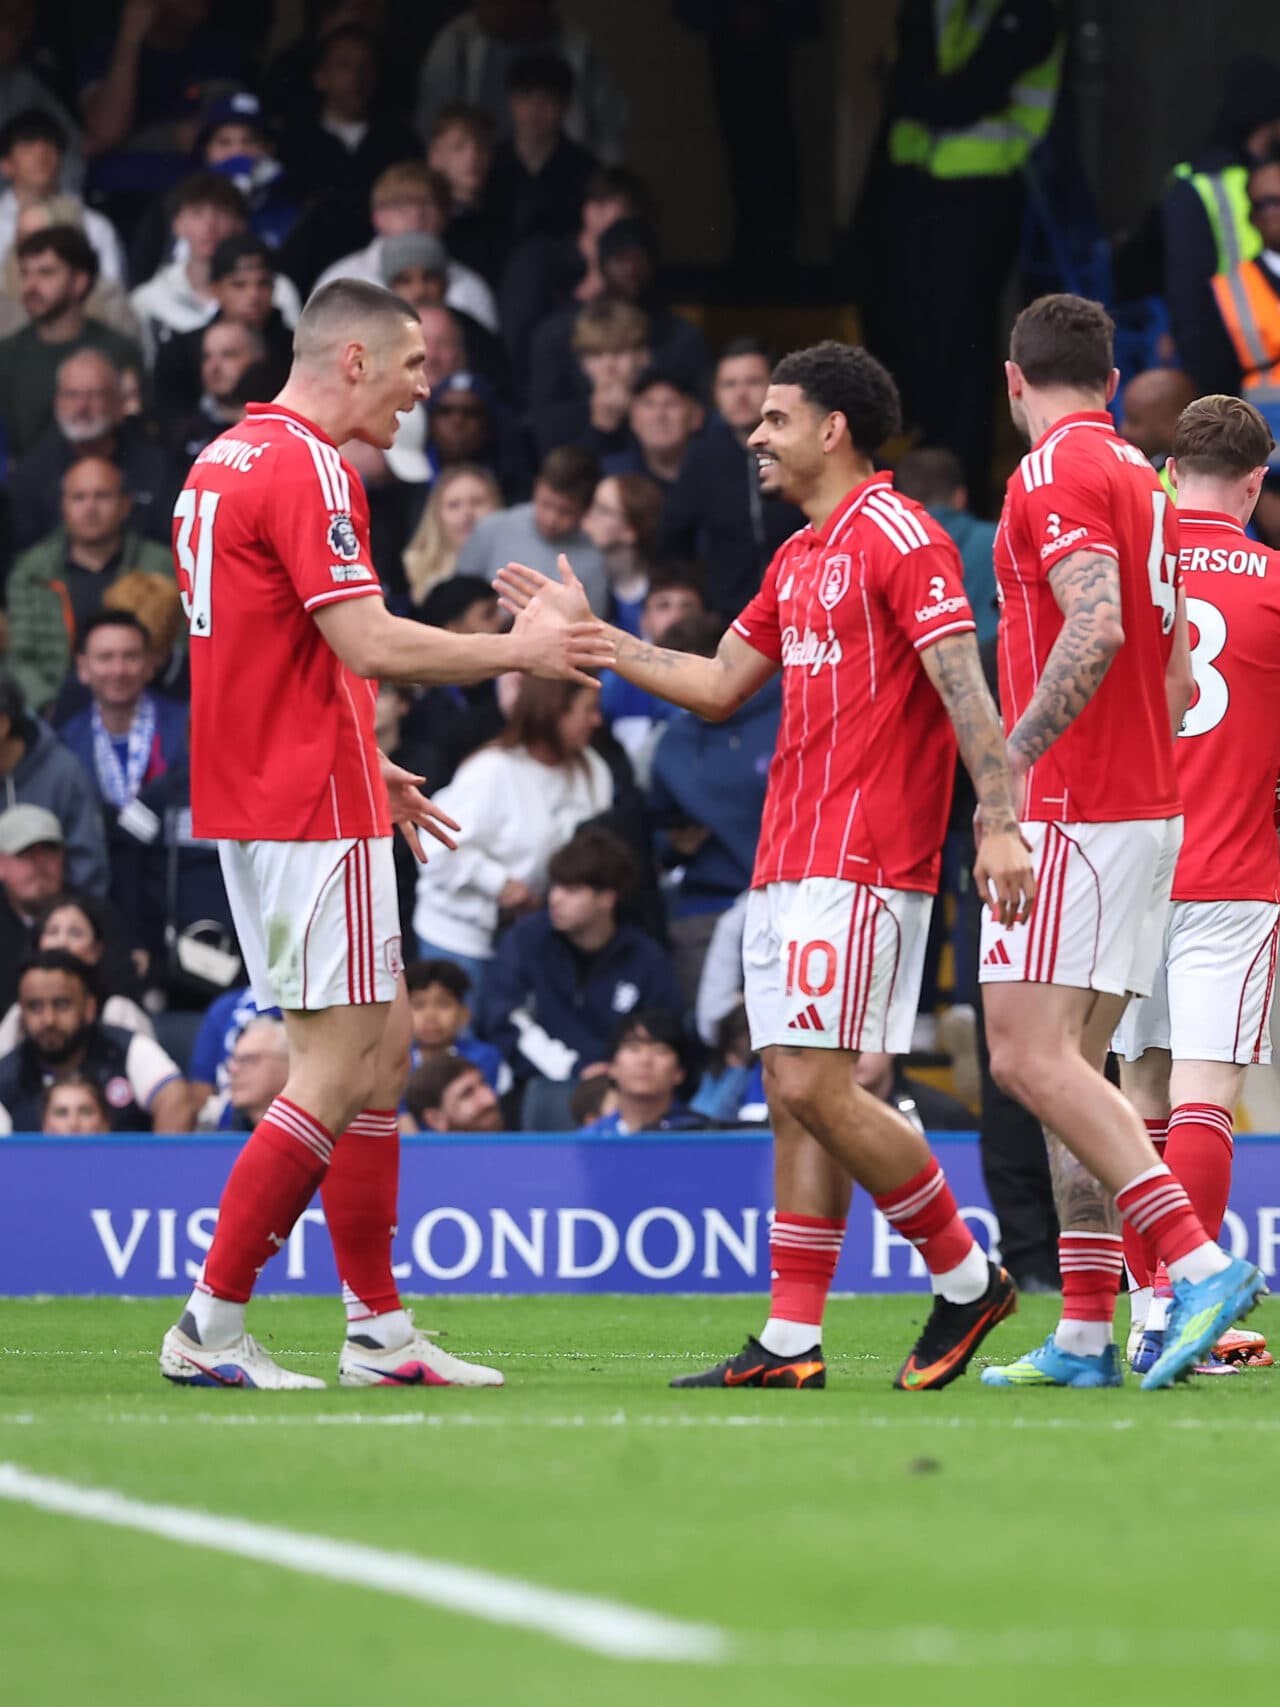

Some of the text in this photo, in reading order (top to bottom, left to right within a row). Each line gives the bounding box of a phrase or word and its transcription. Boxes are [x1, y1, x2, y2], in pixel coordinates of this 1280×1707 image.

[173, 488, 221, 638] 31
[1147, 490, 1177, 636] 4
[1178, 547, 1268, 579] ERSON
[785, 940, 838, 998] 10
[90, 1207, 328, 1280] VIST
[391, 1206, 775, 1280] ONDON'
[871, 1206, 1002, 1278] HO
